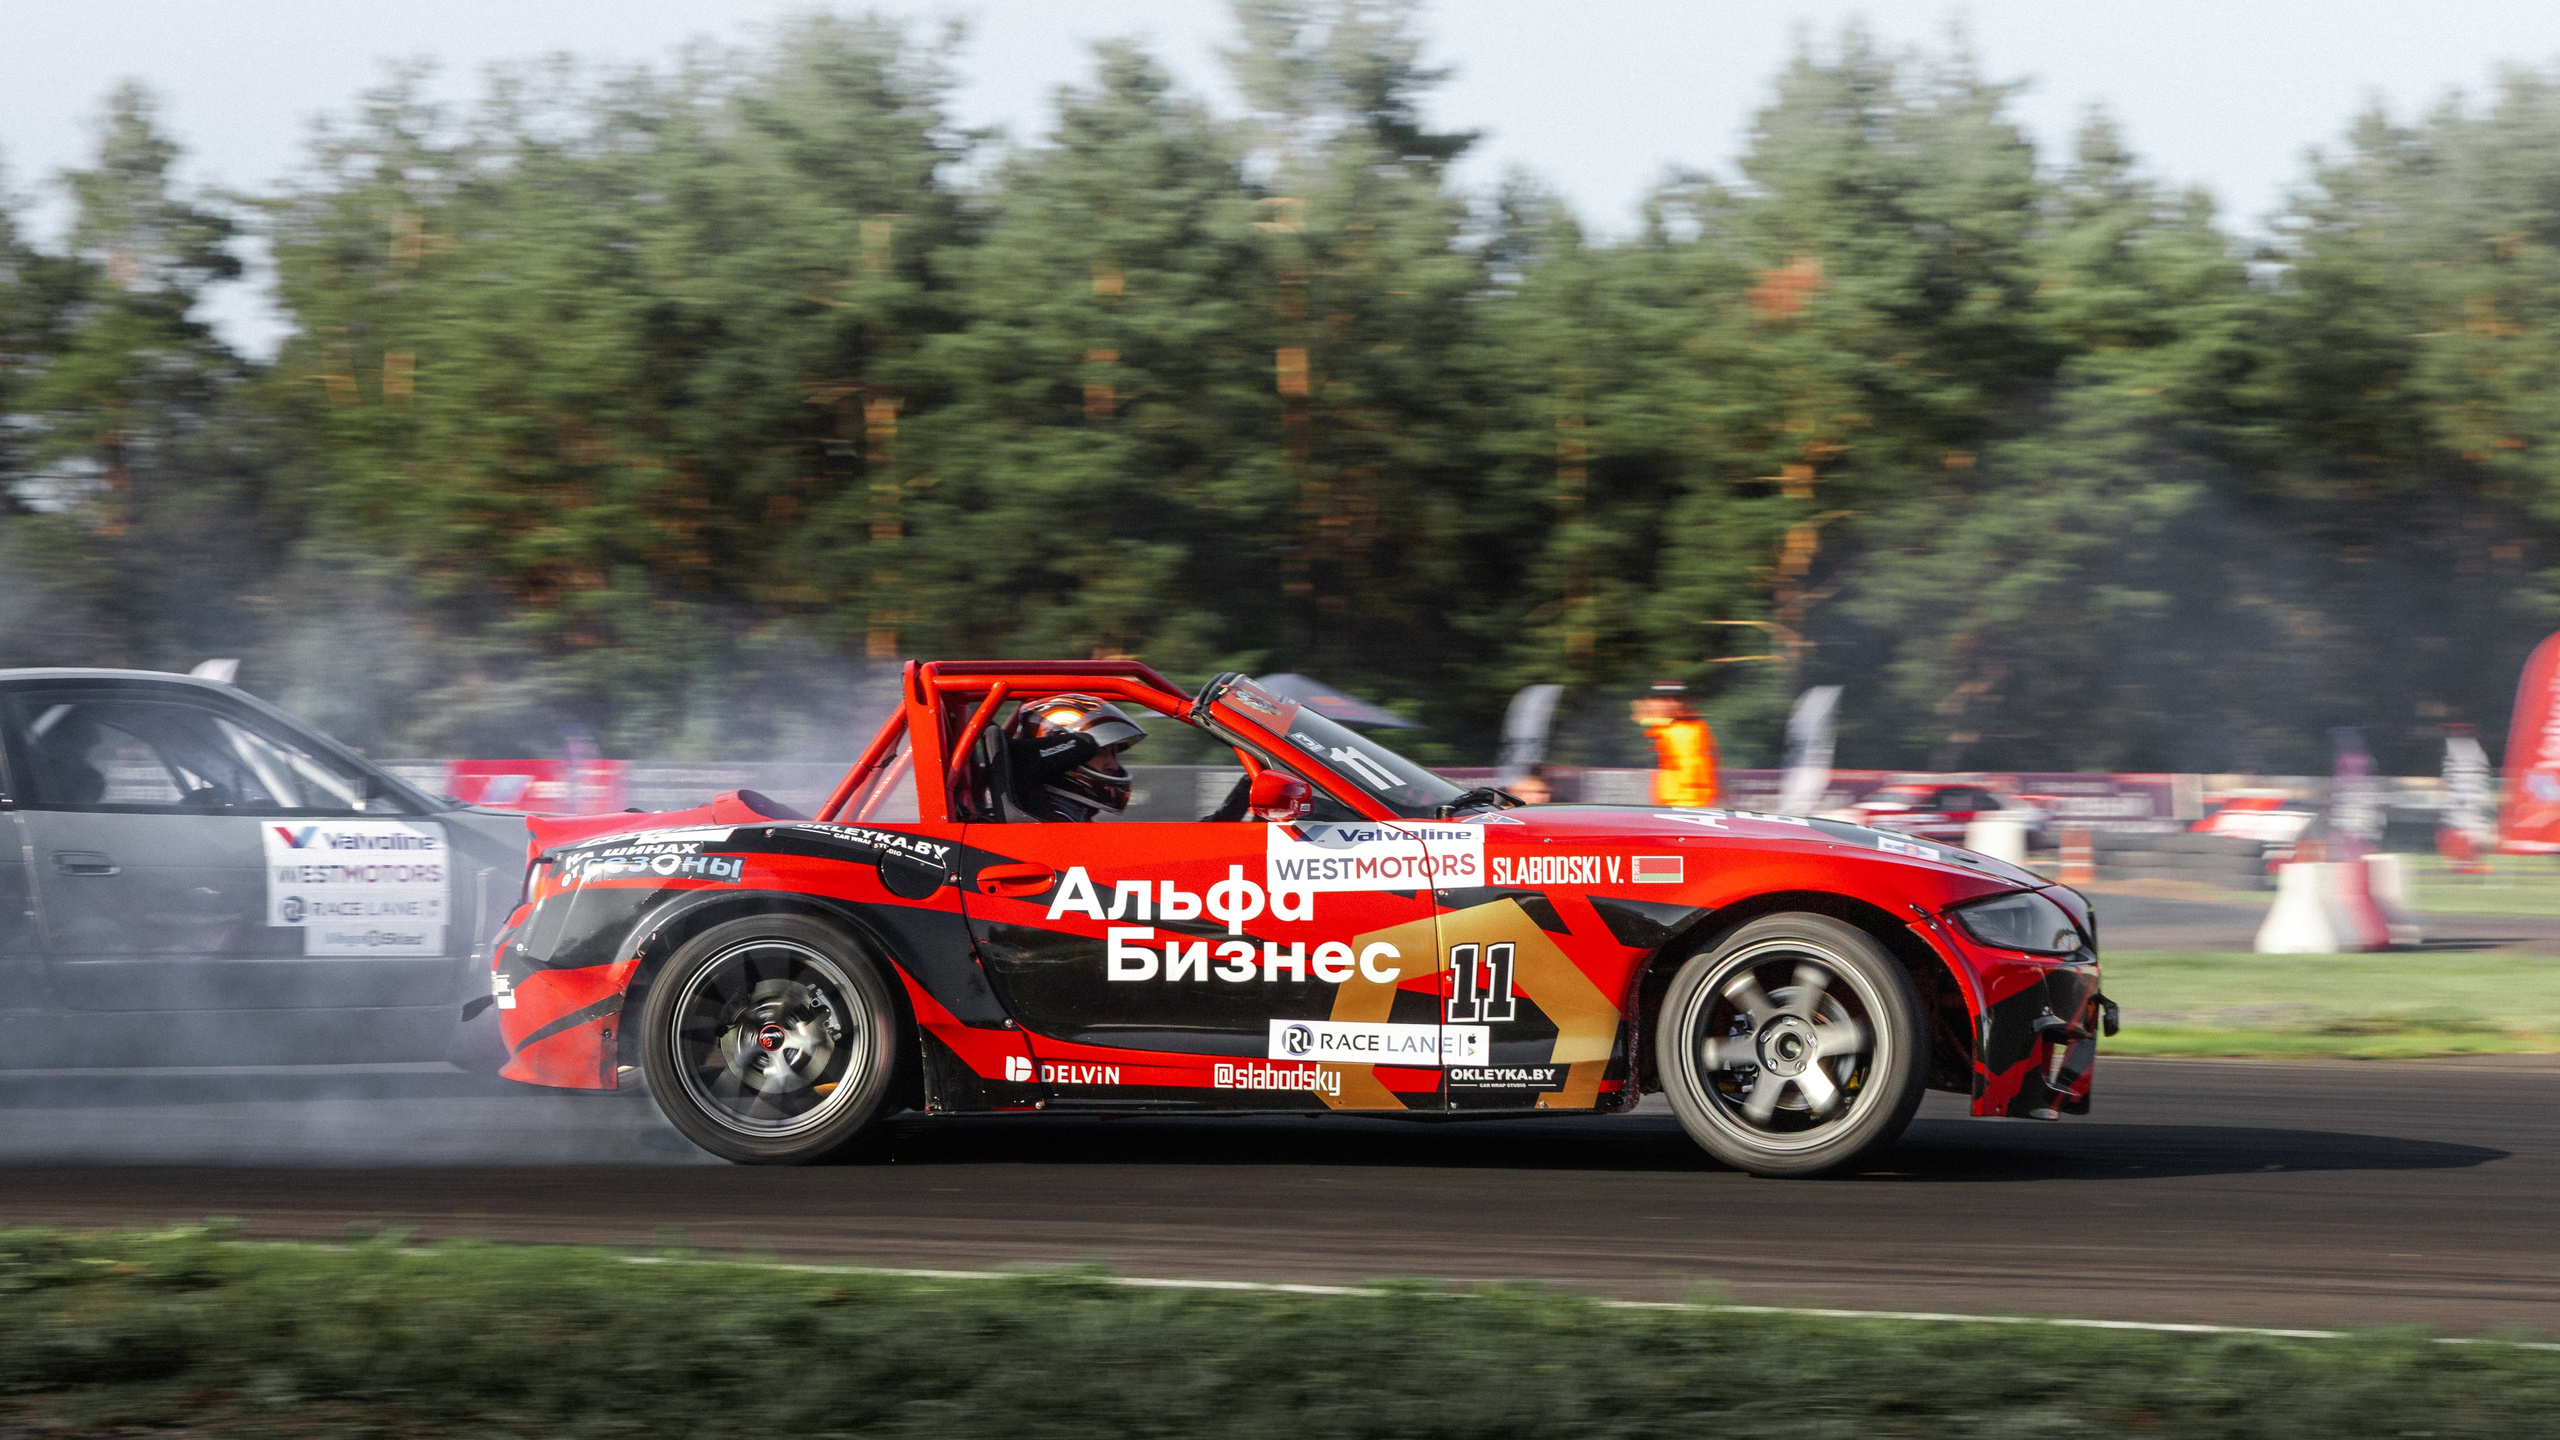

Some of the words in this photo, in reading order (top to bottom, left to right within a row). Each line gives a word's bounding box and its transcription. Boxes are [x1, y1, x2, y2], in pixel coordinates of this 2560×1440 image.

[1329, 745, 1408, 791] 11
[796, 822, 951, 860] OKLEYKA.BY
[833, 832, 851, 841] CAR
[1336, 828, 1472, 842] Valvoline
[1275, 852, 1476, 881] WESTMOTORS
[1492, 855, 1600, 885] SLABODSKI
[1605, 855, 1625, 884] V.
[1045, 864, 1314, 936] Альфа
[1107, 926, 1401, 983] Бизнес
[1447, 941, 1517, 1023] 11
[1320, 1033, 1380, 1051] RACE
[1386, 1034, 1453, 1053] LANE
[1214, 1062, 1341, 1096] @slabodsky
[1450, 1068, 1556, 1081] OKLEYKA.BY
